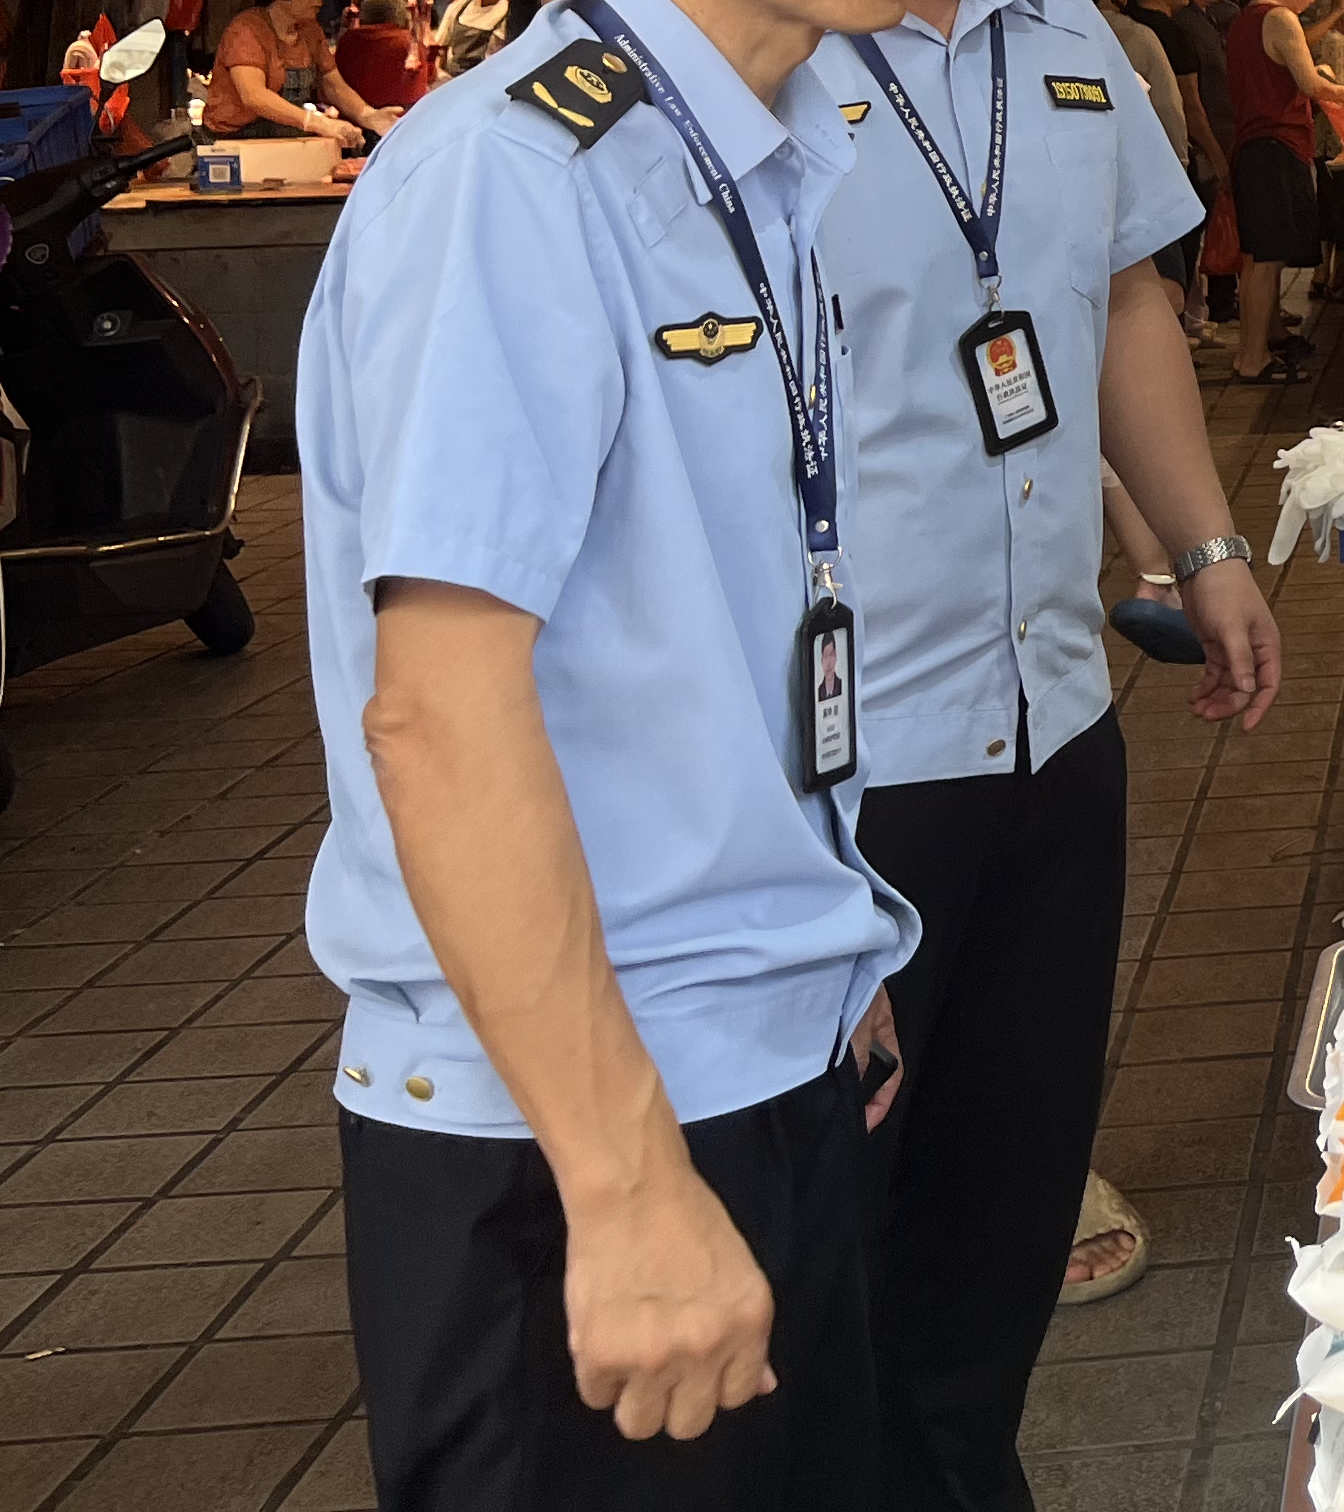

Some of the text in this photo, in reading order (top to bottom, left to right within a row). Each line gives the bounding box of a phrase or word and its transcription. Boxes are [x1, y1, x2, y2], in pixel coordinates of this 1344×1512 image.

[613, 31, 668, 98] Administrative
[683, 120, 723, 183] Enforcement
[712, 177, 736, 215] China
